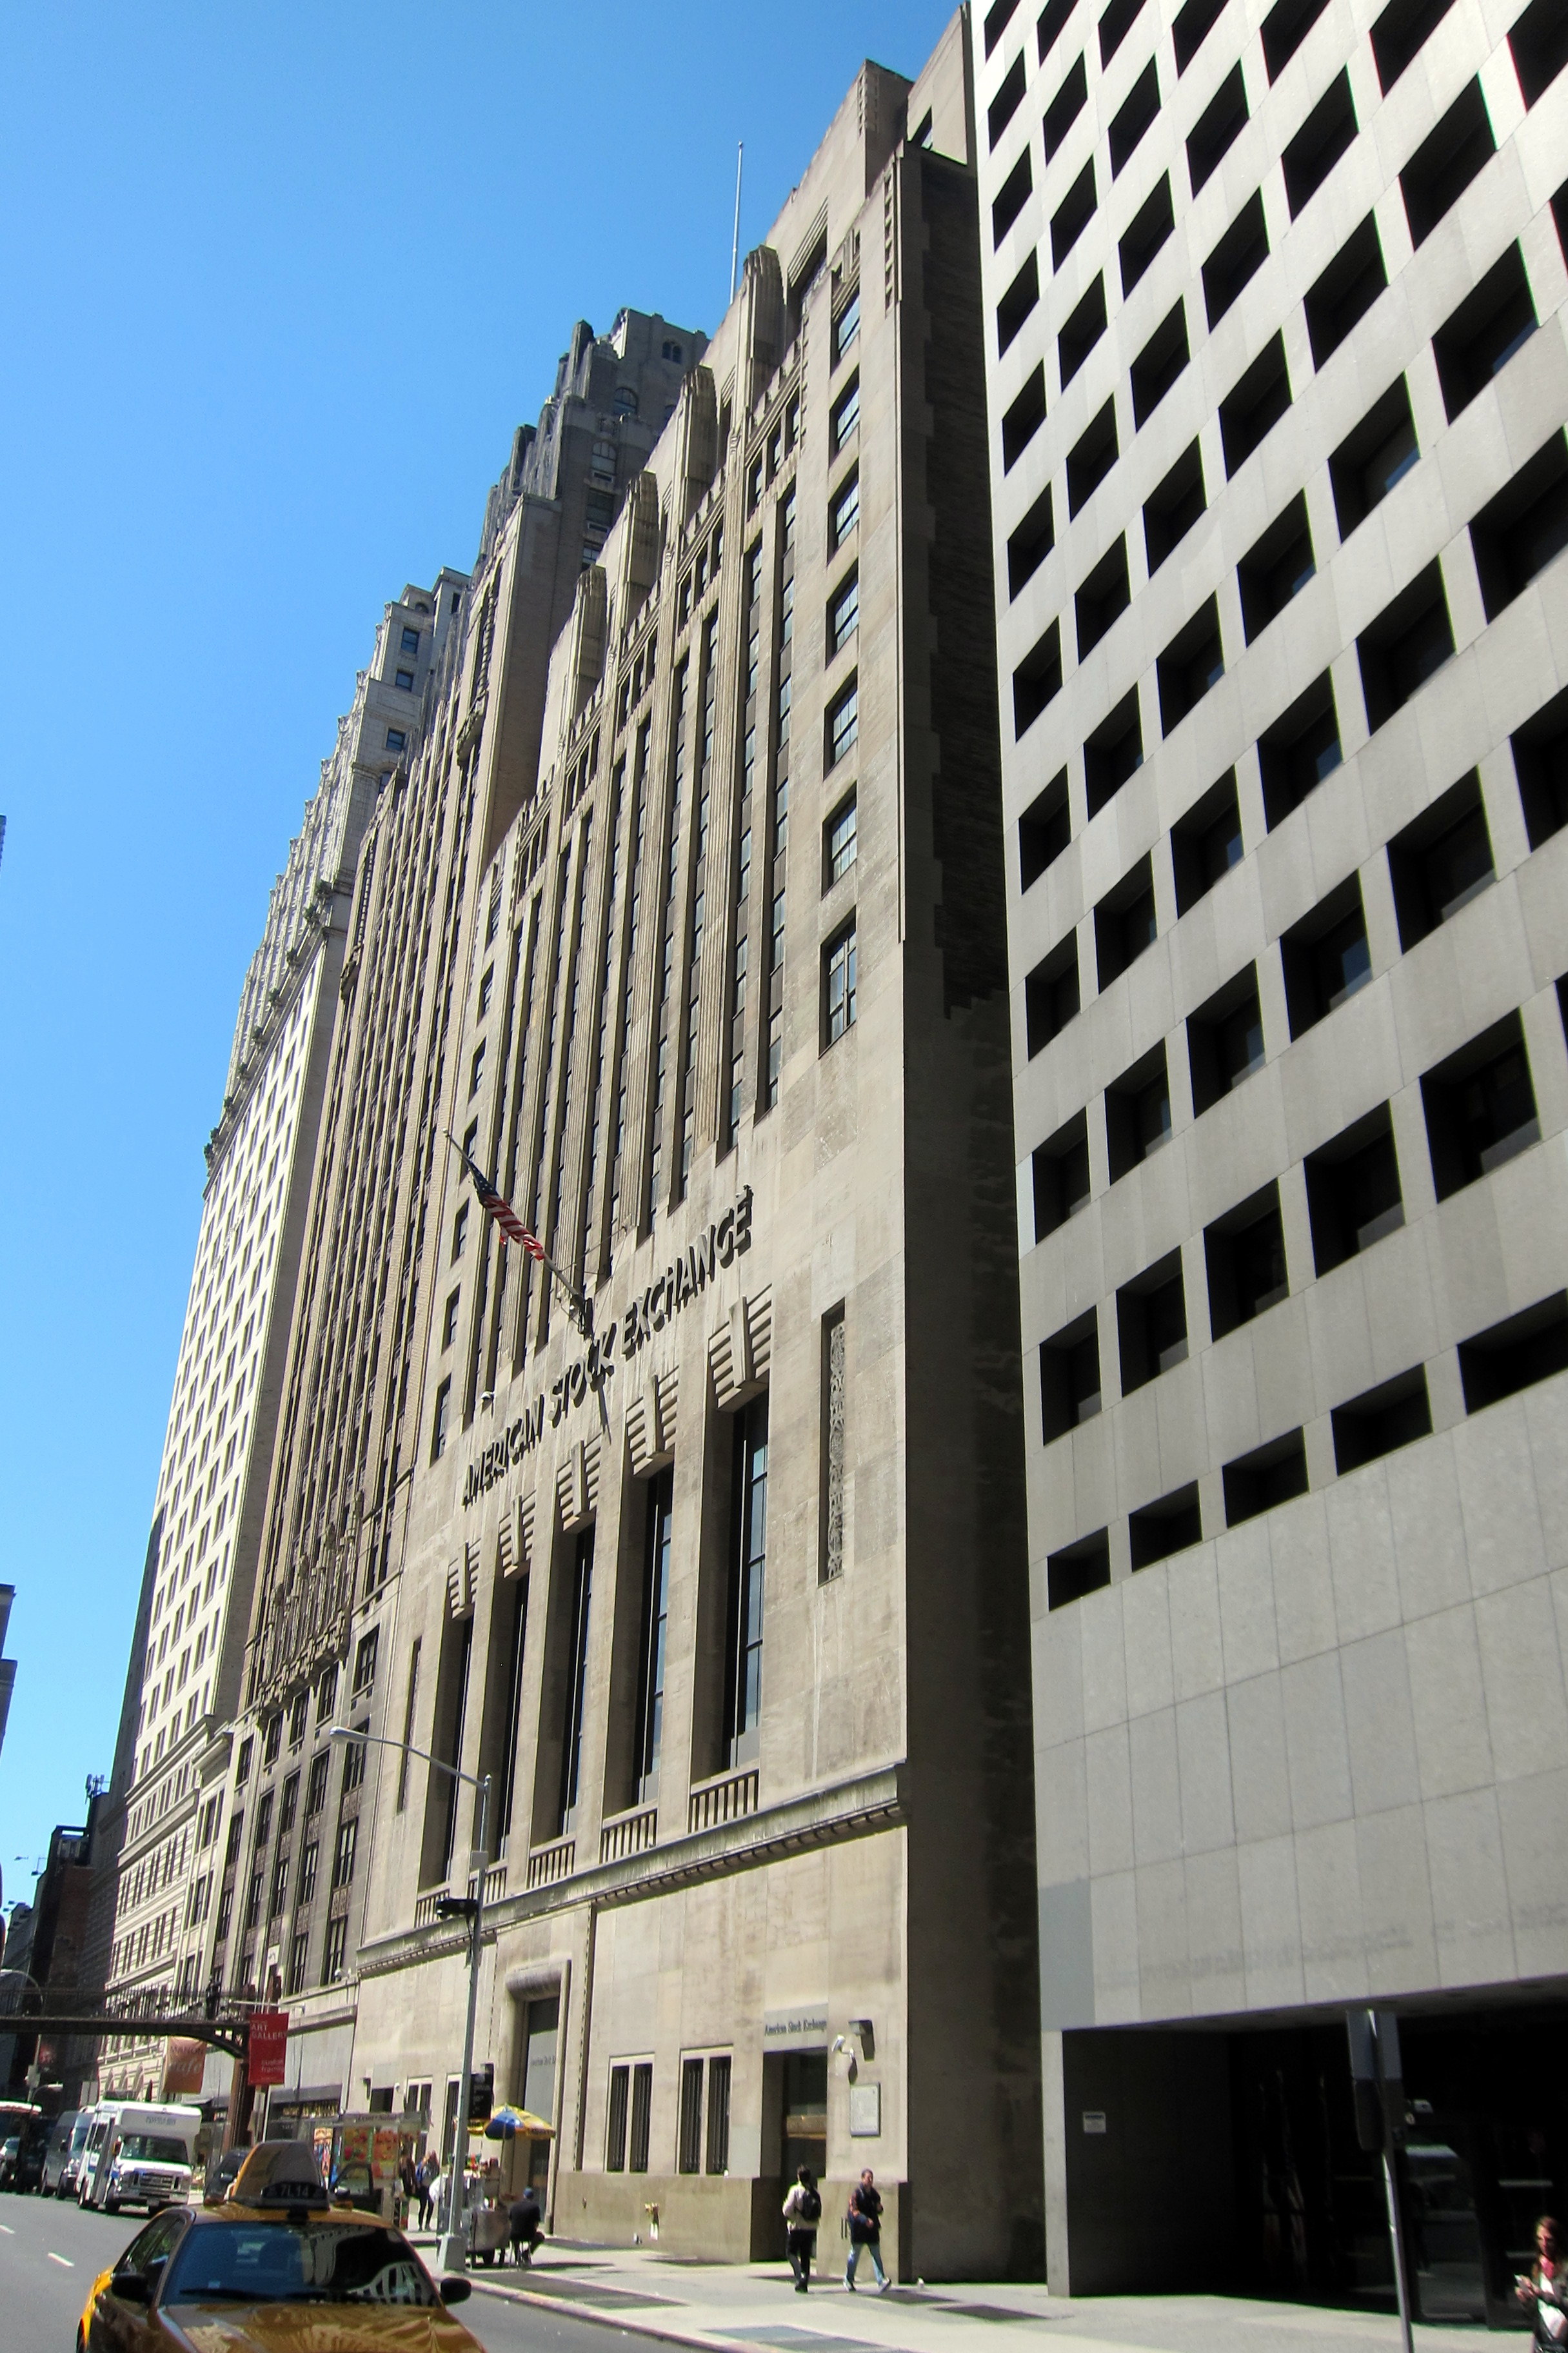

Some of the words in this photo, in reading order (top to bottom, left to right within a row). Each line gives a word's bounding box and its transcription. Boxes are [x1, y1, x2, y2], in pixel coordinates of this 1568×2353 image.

[461, 1393, 545, 1513] AMERICAN
[549, 1322, 615, 1429] STOCK
[621, 1191, 753, 1361] EXCHANGE
[252, 2023, 268, 2032] ART
[252, 2032, 286, 2040] GALLERY
